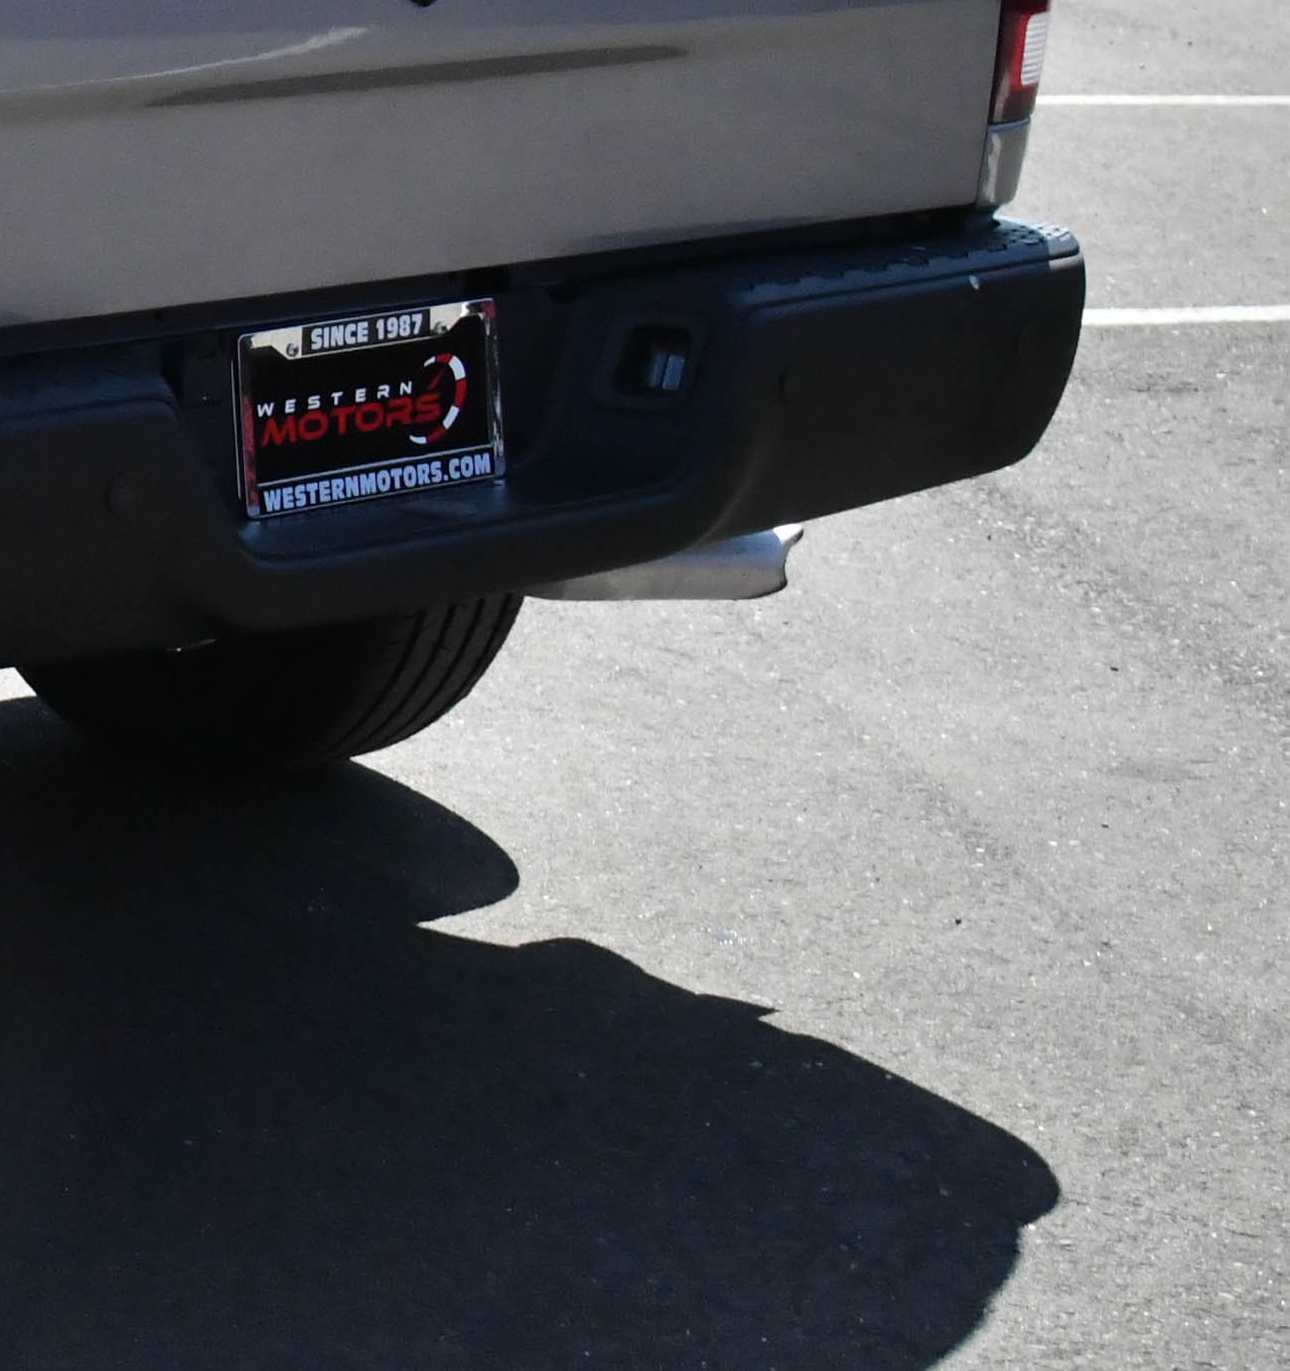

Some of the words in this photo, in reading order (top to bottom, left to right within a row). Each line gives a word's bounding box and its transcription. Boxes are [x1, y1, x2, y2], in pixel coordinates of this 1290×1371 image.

[310, 321, 369, 350] SINCE
[376, 313, 424, 340] 1987
[257, 381, 413, 417] WESTERN
[262, 392, 443, 448] MOTORS
[263, 453, 491, 513] WESTERNMOTORS.COM
